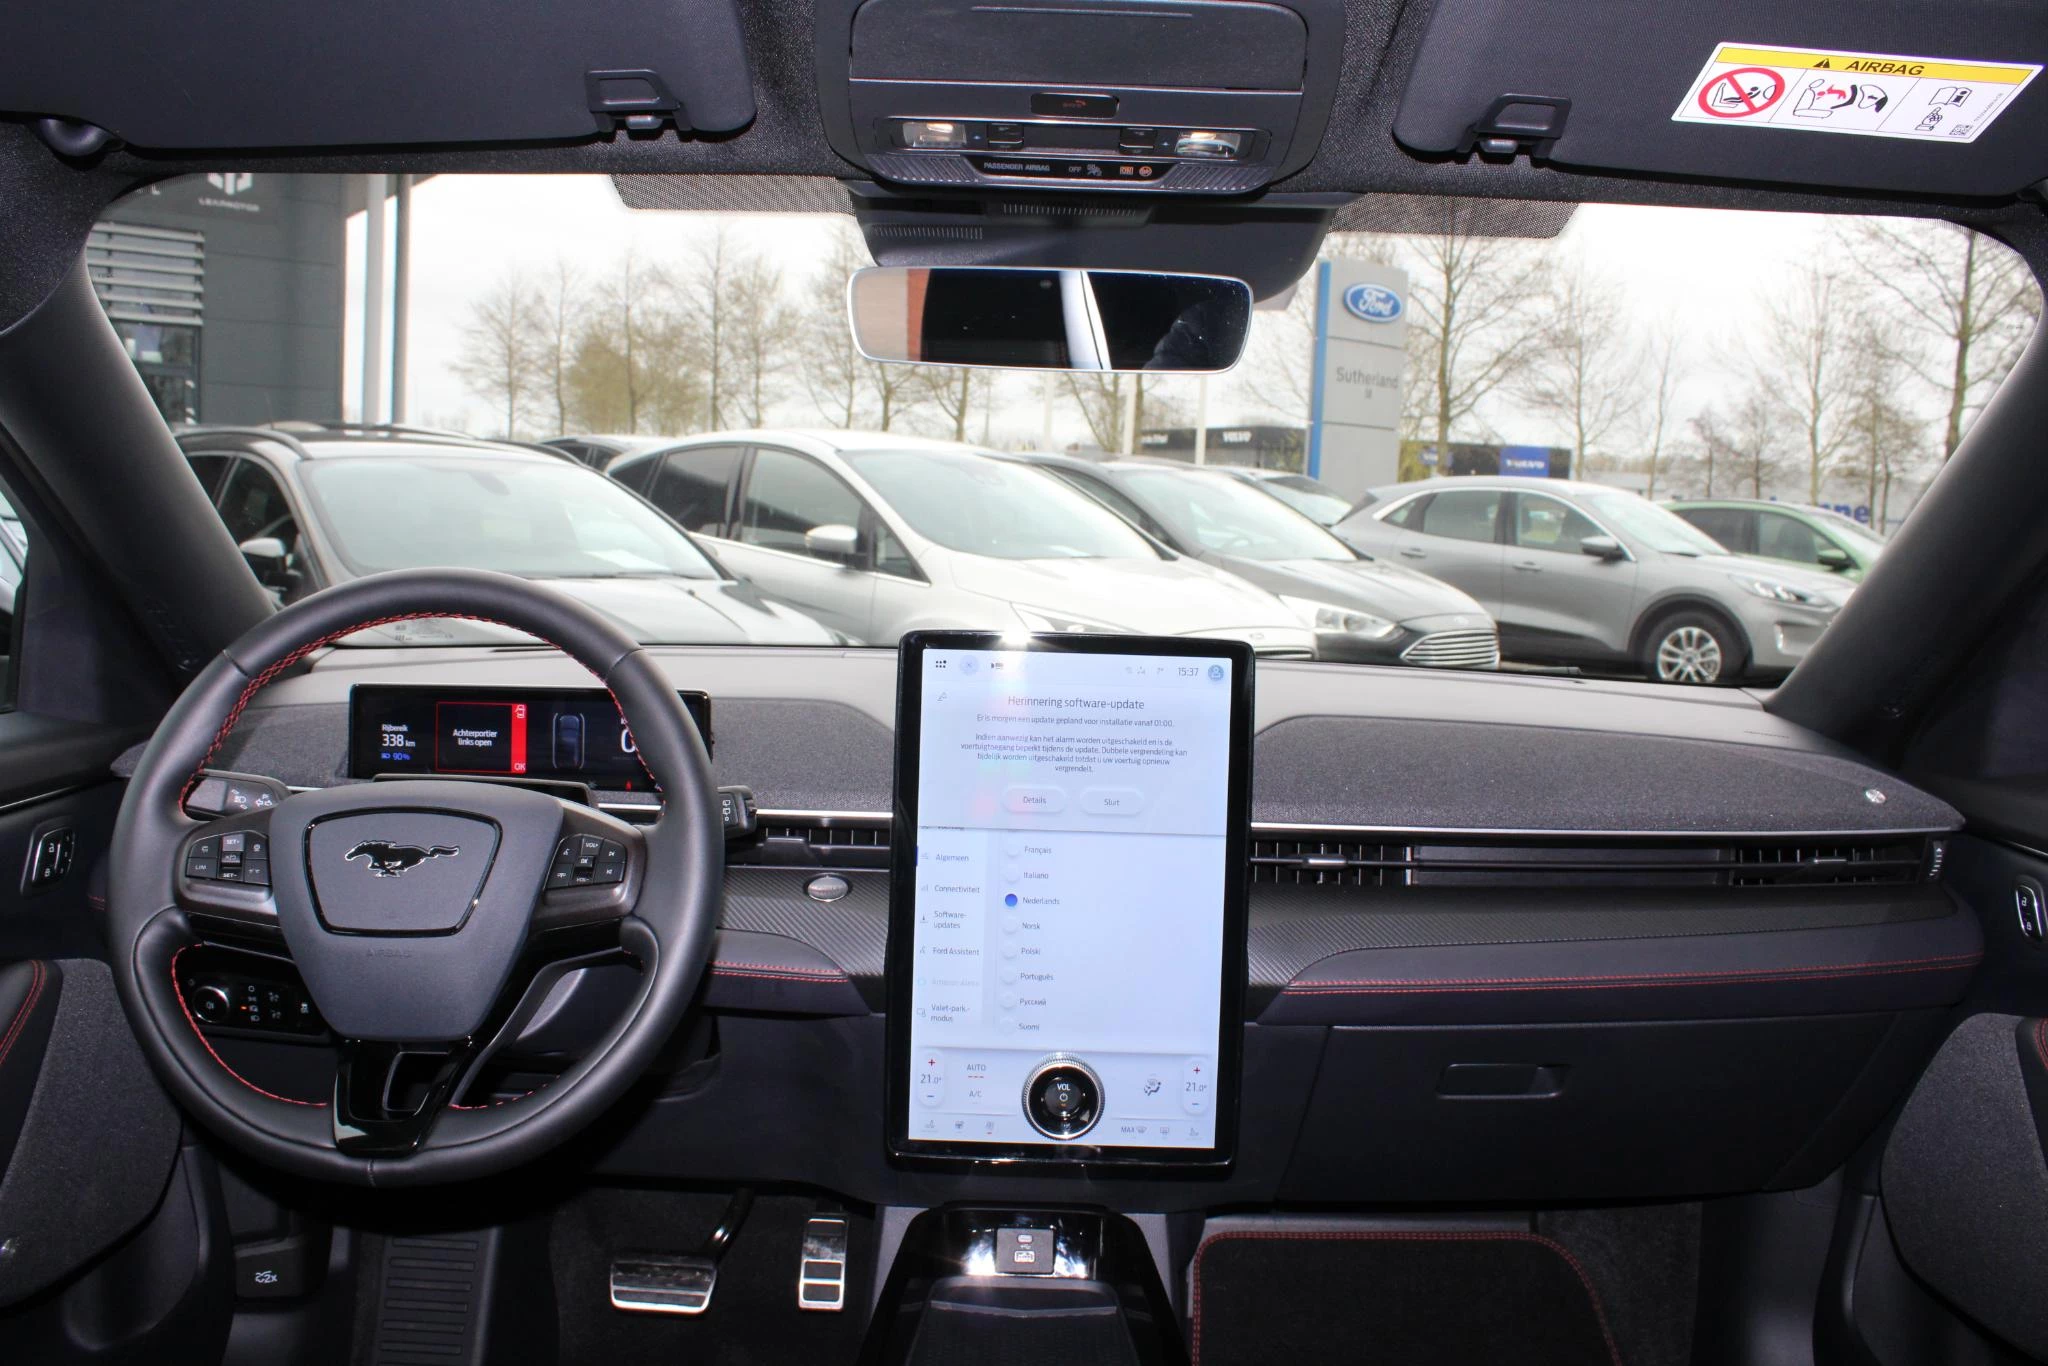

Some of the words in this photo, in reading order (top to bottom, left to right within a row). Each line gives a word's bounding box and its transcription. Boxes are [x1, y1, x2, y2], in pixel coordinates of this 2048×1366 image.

[1845, 60, 1926, 76] AIRBAG
[983, 162, 1024, 170] PASSENGER
[1025, 164, 1050, 172] AIRBAG
[1069, 165, 1082, 173] OFF
[1358, 288, 1394, 316] Ford
[1336, 366, 1399, 389] Sutherland
[1178, 667, 1199, 677] 15:37
[1007, 696, 1063, 708] Herinnering
[1064, 698, 1145, 711] software-update
[1031, 716, 1055, 725] update
[1133, 719, 1152, 727] vanaf
[452, 729, 498, 738] Achterportier
[382, 734, 404, 747] 338
[405, 739, 416, 747] km
[458, 738, 475, 746] links
[474, 739, 492, 747] open
[392, 752, 410, 761] 90%
[514, 763, 526, 771] OK
[1023, 796, 1047, 805] Details
[1024, 846, 1052, 855] Français
[1023, 871, 1049, 879] Italiano
[934, 884, 980, 893] Connectiviteit
[1022, 896, 1060, 905] Nederlands
[934, 910, 967, 919] Software-
[933, 921, 960, 930] updates
[1022, 921, 1040, 930] Norsk
[932, 947, 948, 955] Ford
[949, 947, 980, 956] Assistent
[1021, 947, 1041, 955] Polski
[1020, 972, 1054, 981] Português
[930, 1015, 953, 1023] modus
[1018, 1022, 1040, 1031] Suomi
[966, 1063, 987, 1072] AUTO
[1057, 1083, 1071, 1091] VOL
[969, 1090, 983, 1098] A/C
